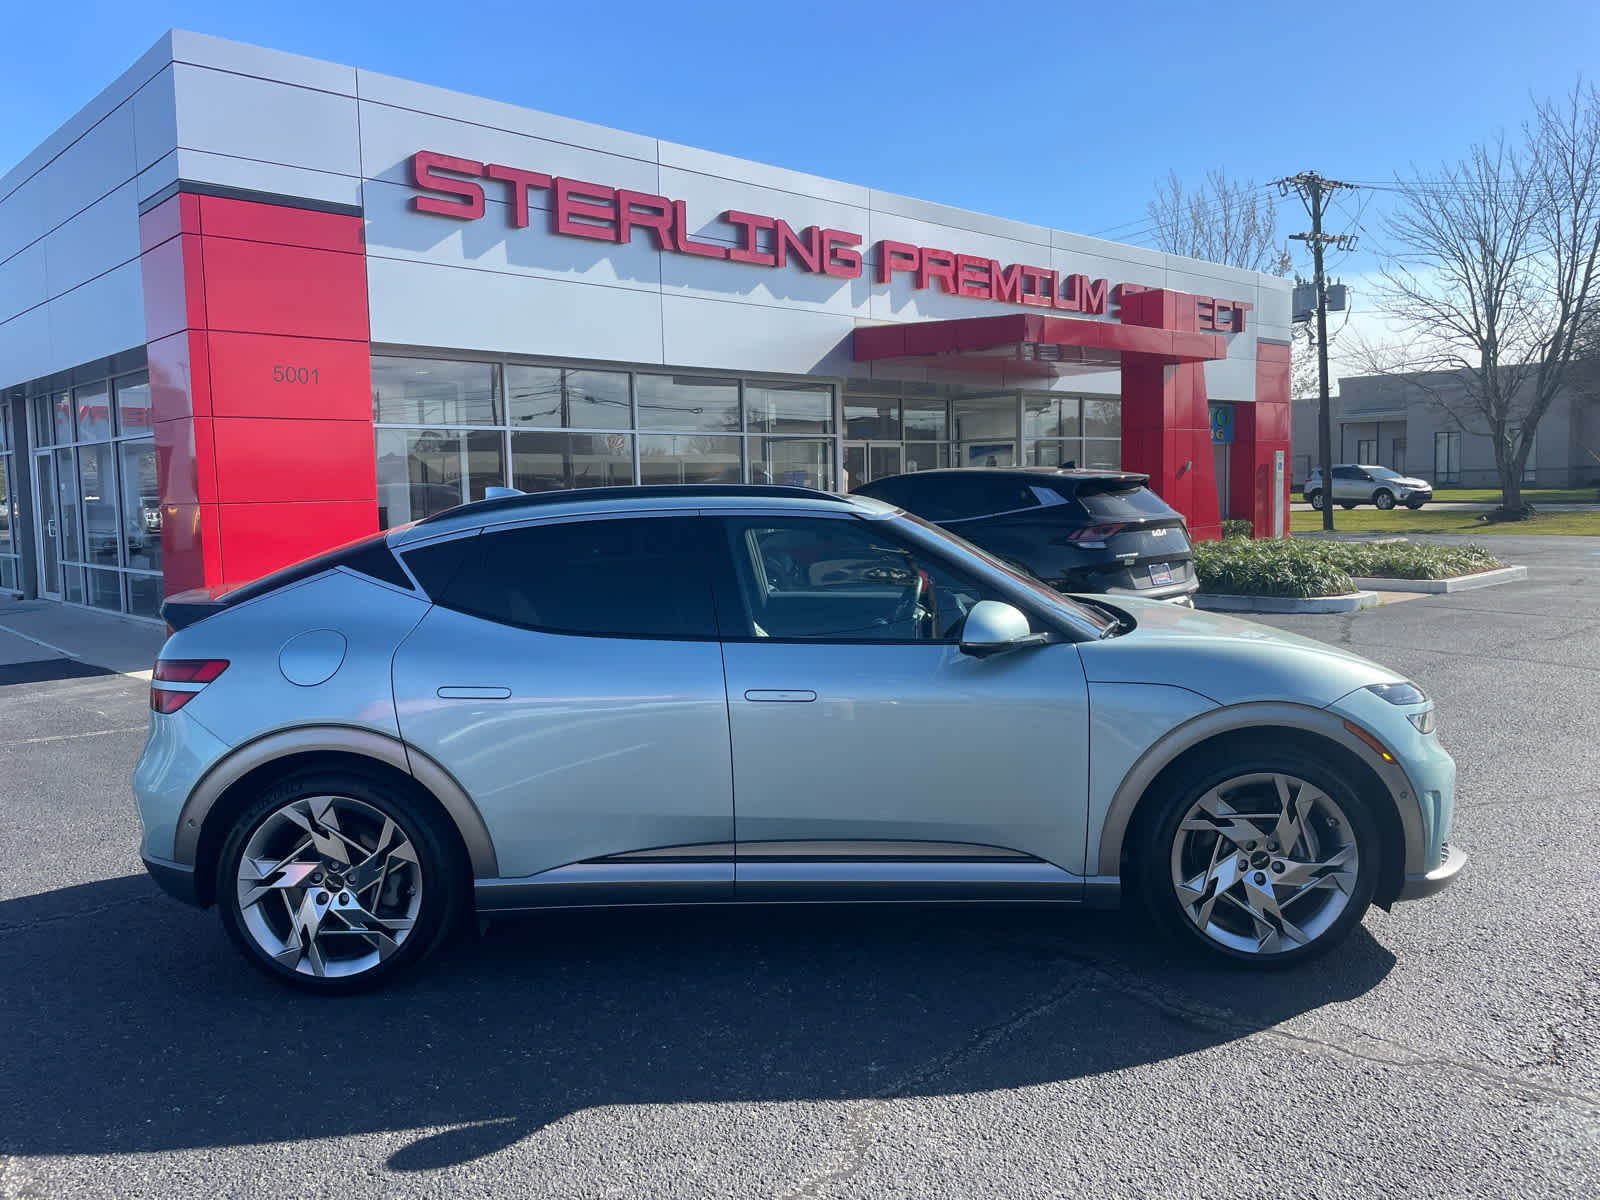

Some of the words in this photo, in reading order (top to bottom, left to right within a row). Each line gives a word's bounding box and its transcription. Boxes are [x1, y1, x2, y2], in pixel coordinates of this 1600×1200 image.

[410, 150, 863, 279] STERLING
[876, 239, 1108, 315] PREMIUM
[1109, 282, 1254, 333] ECT
[272, 364, 319, 385] 5001
